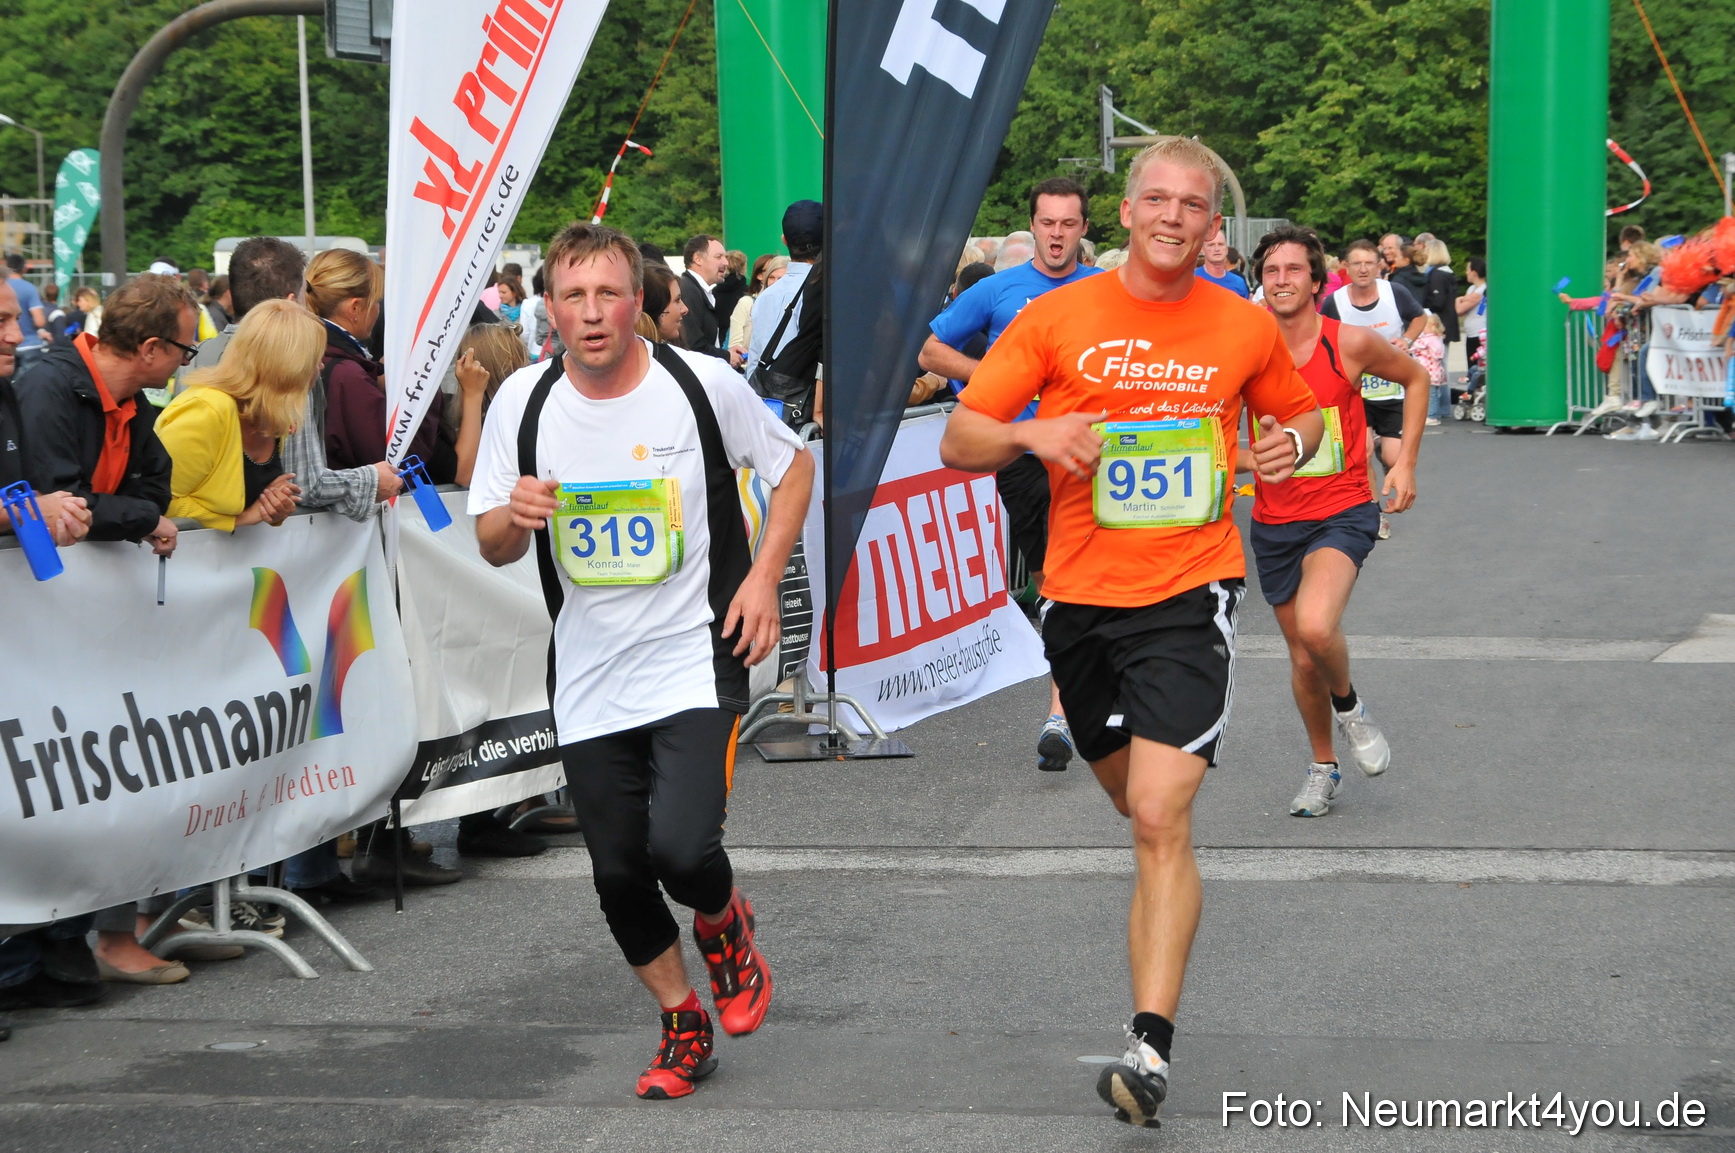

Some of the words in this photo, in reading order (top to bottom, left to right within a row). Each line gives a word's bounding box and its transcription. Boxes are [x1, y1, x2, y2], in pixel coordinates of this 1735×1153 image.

[409, 115, 484, 240] XL
[452, 0, 558, 145] Prin
[1103, 356, 1219, 381] Fischer
[1113, 380, 1208, 393] AUTOMOBILE
[1130, 403, 1154, 414] und
[1157, 400, 1180, 413] das
[1111, 443, 1153, 452] firmenlauf
[1108, 456, 1192, 501] 951
[569, 502, 609, 511] firmenlauf
[1123, 503, 1156, 512] Martin
[569, 515, 655, 558] 319
[587, 560, 623, 569] Konrad
[855, 475, 1005, 647] MEIER
[0, 683, 312, 819] Frischmann
[479, 738, 508, 762] die
[184, 789, 248, 837] Druck
[270, 763, 356, 806] Medien
